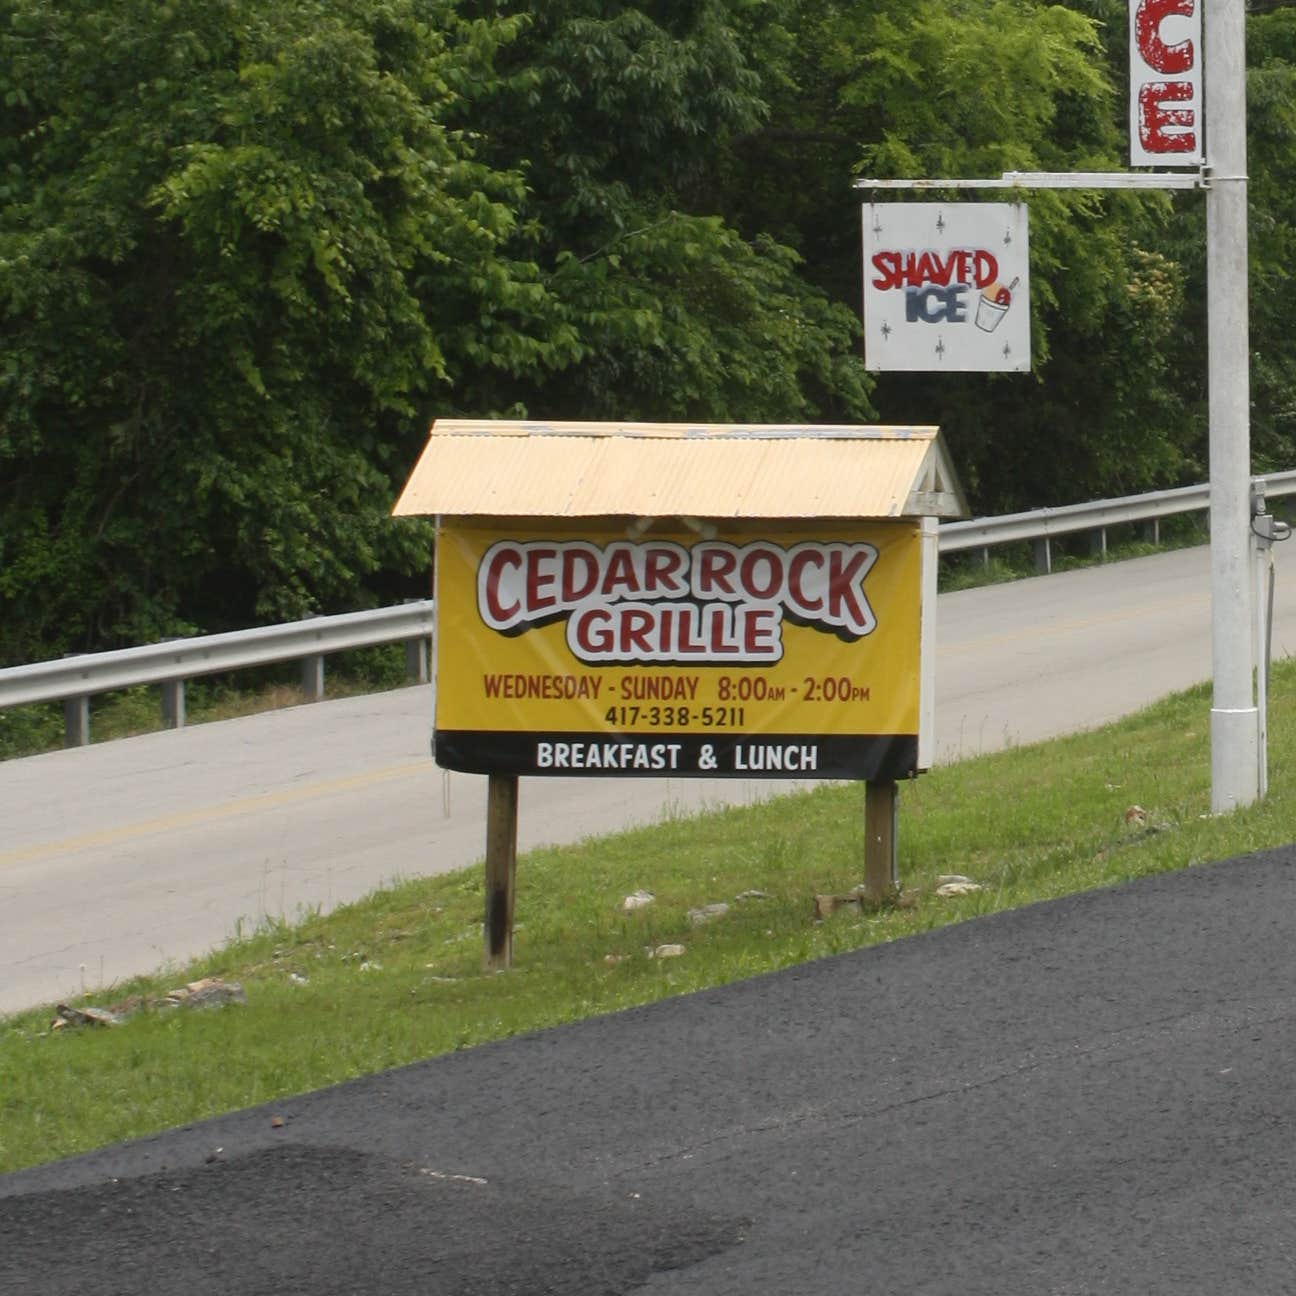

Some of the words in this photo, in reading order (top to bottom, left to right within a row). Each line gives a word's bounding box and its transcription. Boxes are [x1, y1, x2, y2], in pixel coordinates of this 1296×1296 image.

[871, 249, 999, 290] SHAVED
[904, 283, 970, 323] ICE
[485, 547, 682, 622] CEDAR
[690, 547, 873, 628] ROCK
[576, 608, 776, 654] GRILLE
[484, 674, 602, 699] WEDNESDAY
[621, 676, 699, 700] SUNDAY
[605, 706, 745, 726] 417-338-5211
[537, 742, 682, 768] BREAKFAST
[698, 743, 718, 770] &
[735, 745, 818, 770] LUNCH
